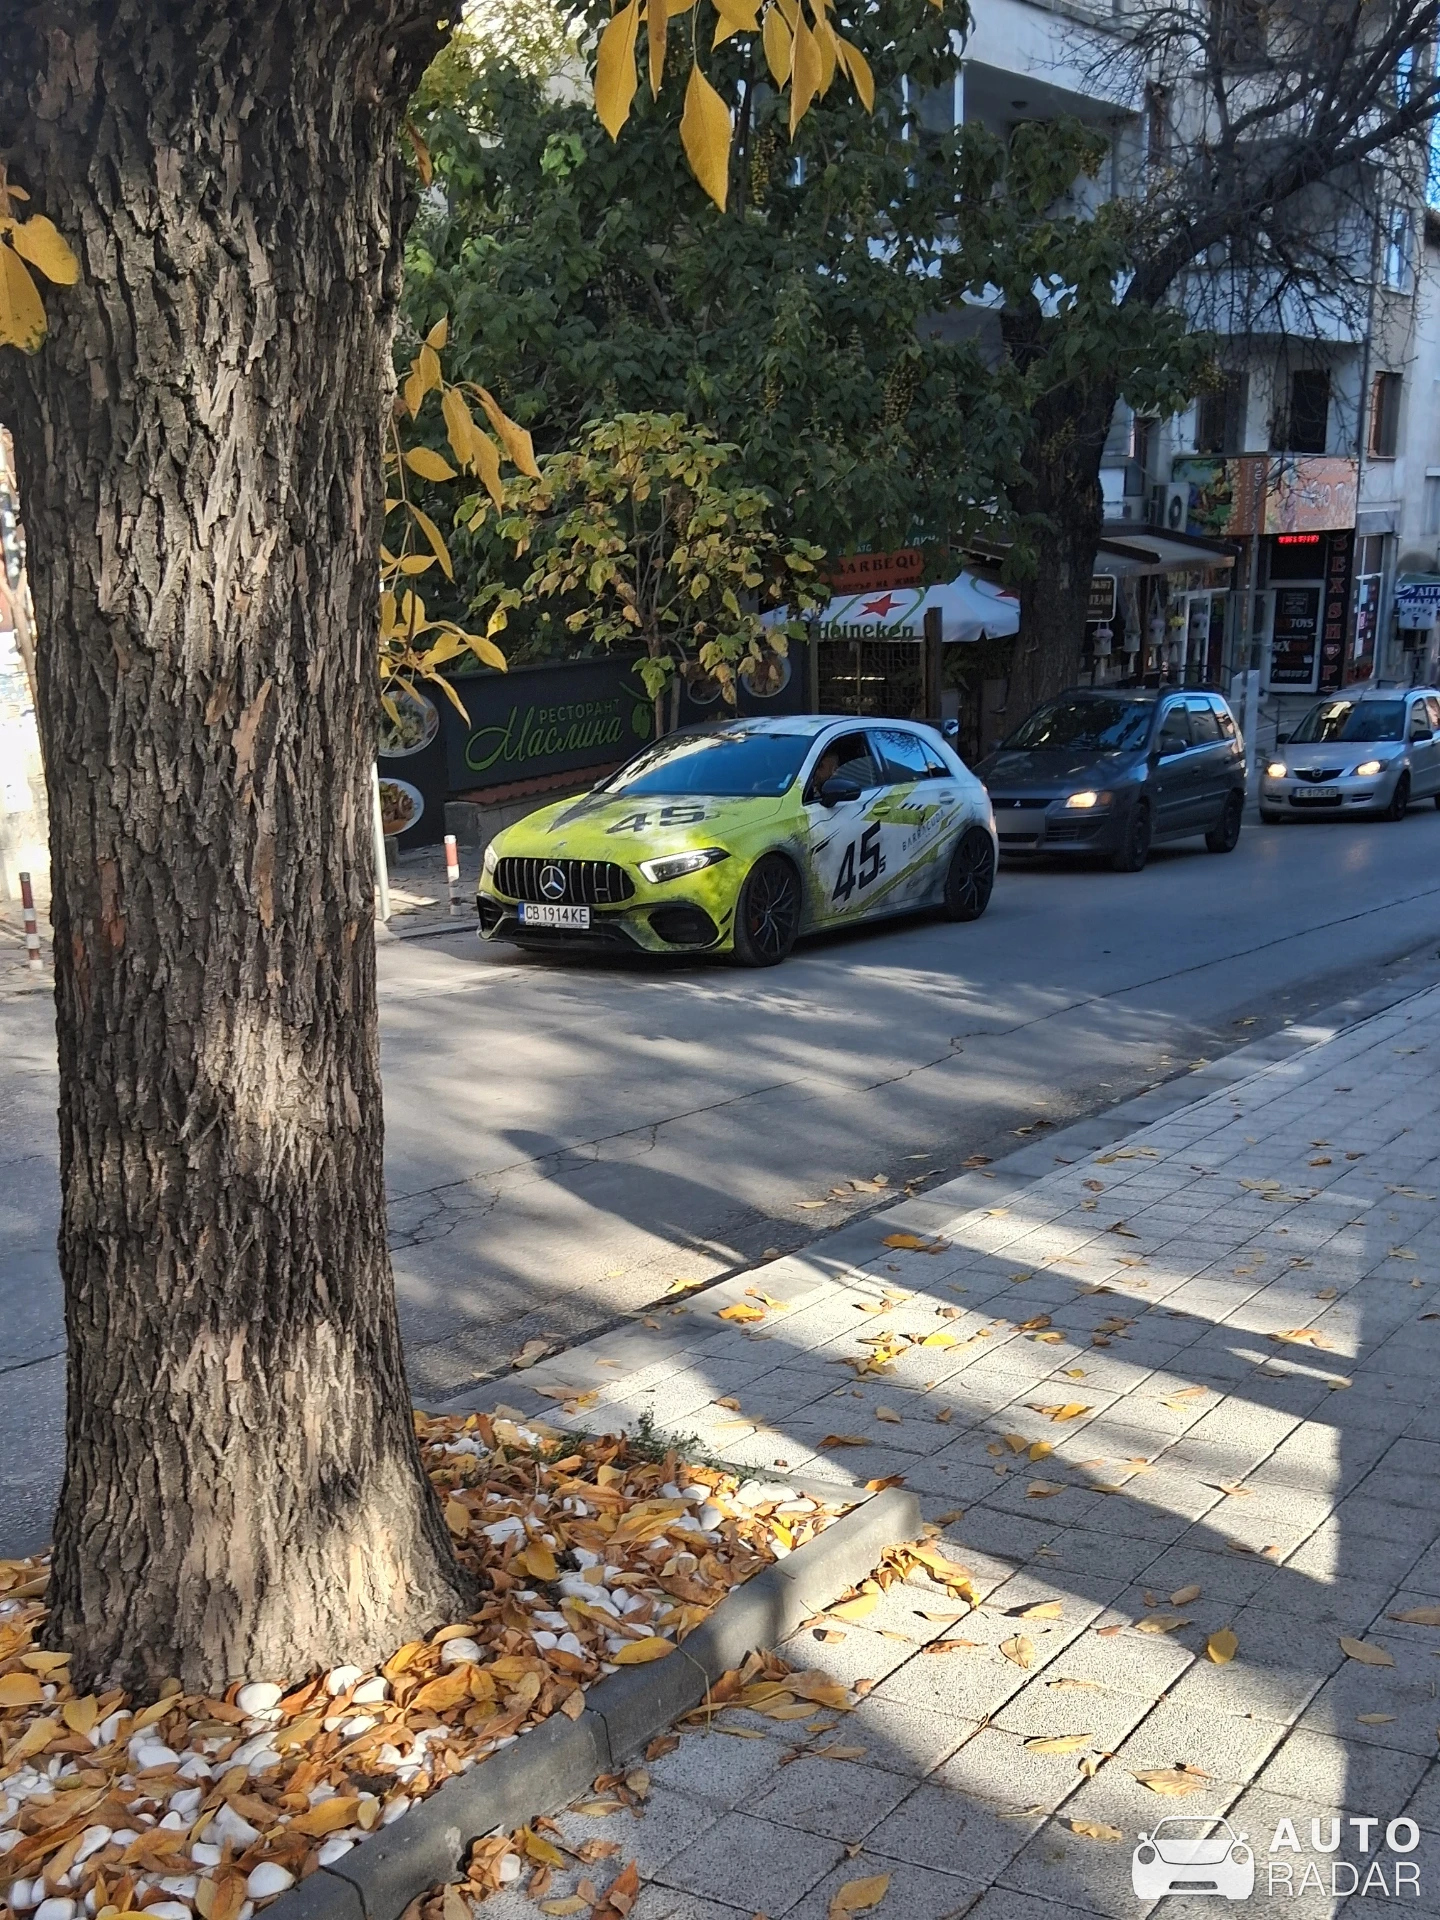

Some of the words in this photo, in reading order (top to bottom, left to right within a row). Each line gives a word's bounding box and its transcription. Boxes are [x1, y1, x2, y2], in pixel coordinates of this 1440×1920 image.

[834, 554, 920, 575] BARBEQU
[818, 620, 914, 641] Heineken
[539, 698, 620, 725] РЕСТОРАНТ
[465, 706, 624, 771] Маслина
[902, 810, 944, 851] BARRACUDA
